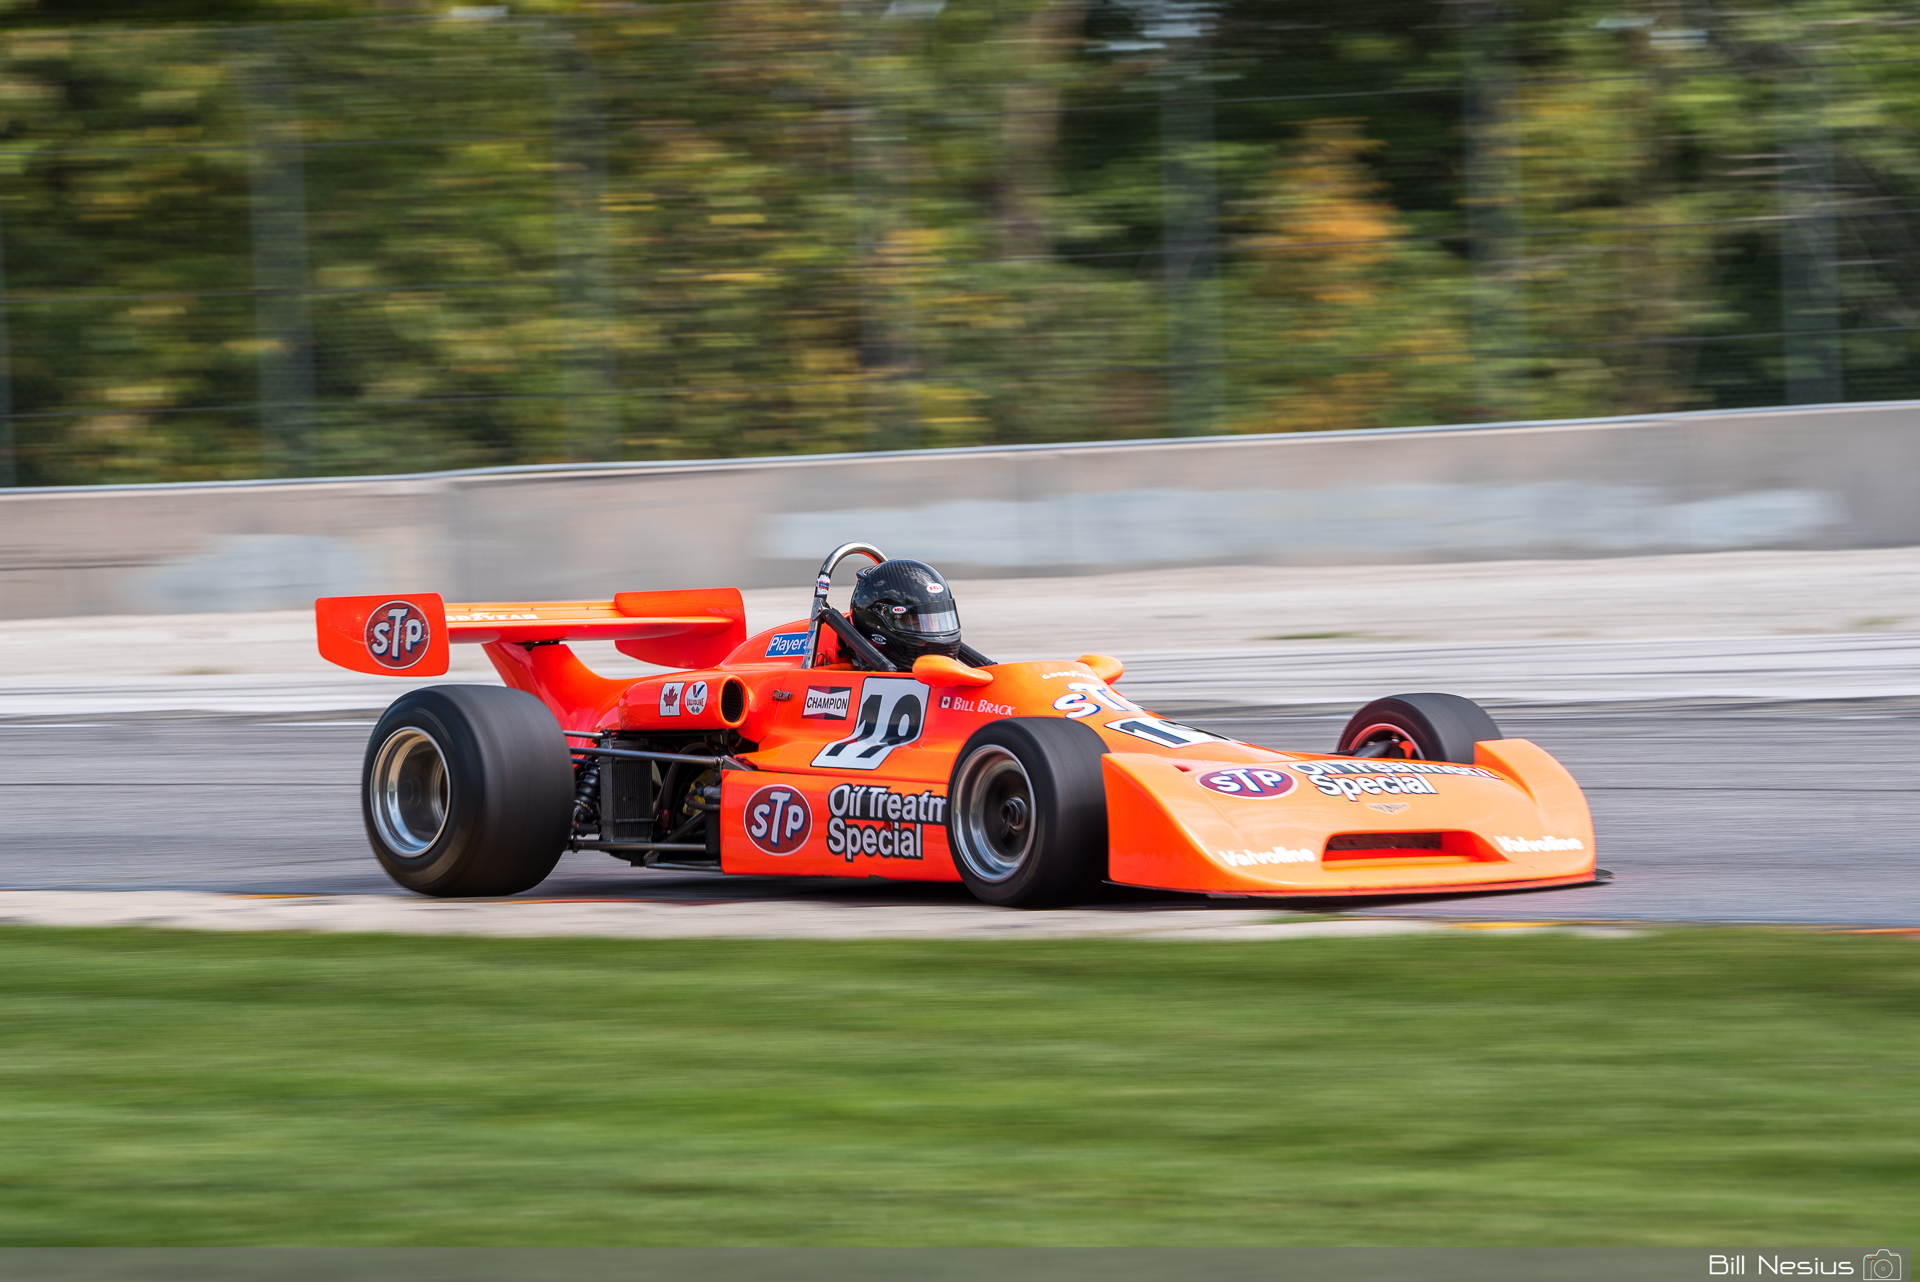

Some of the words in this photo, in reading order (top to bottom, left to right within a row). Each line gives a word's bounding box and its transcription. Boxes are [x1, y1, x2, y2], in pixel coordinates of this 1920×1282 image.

[371, 608, 423, 661] STP
[806, 696, 848, 710] CHAMPION
[953, 696, 974, 712] BILL
[977, 699, 1016, 716] BRACK
[1209, 767, 1285, 794] STP
[1287, 761, 1345, 776] Oil
[829, 784, 867, 817] Oil
[1308, 773, 1439, 802] Special
[750, 791, 805, 847] STP
[827, 817, 923, 861] Special
[1493, 835, 1584, 853] Valvoline
[1217, 846, 1316, 867] Valvoline
